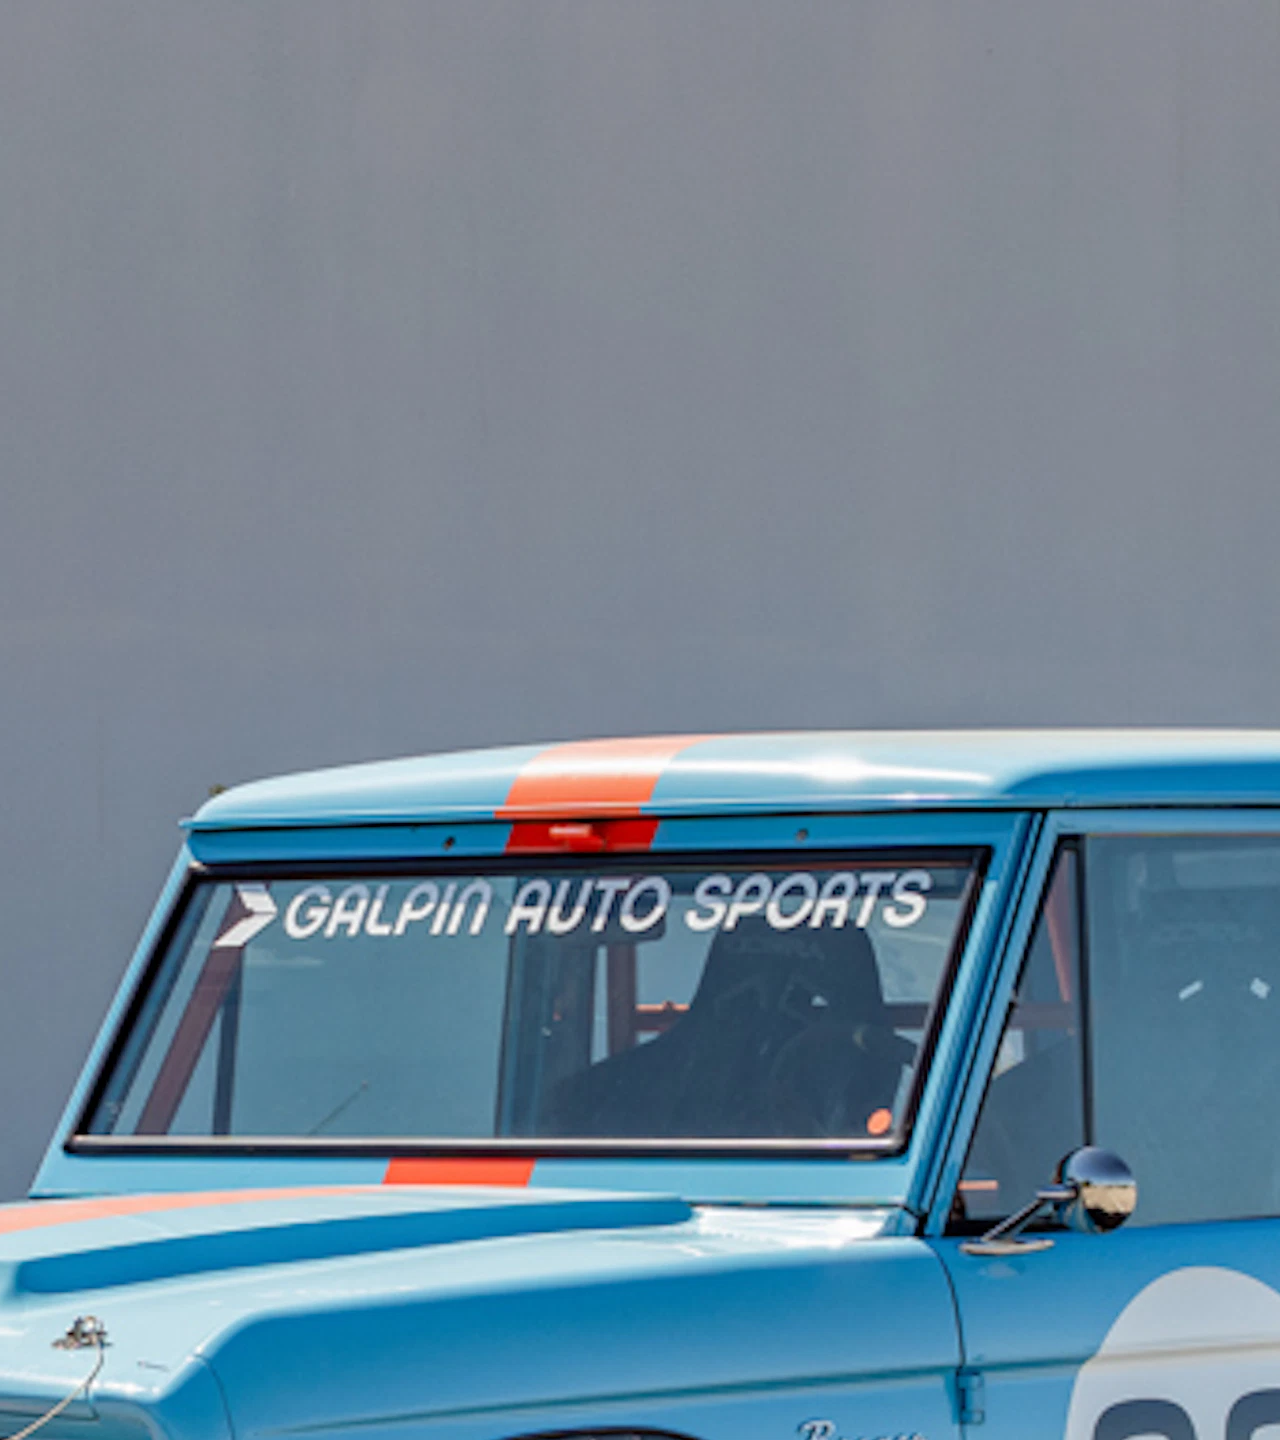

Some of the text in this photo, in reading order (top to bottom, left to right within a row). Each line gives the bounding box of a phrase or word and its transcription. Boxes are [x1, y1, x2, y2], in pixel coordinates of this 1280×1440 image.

[284, 869, 932, 939] GALPIN AUTO SPORTS
